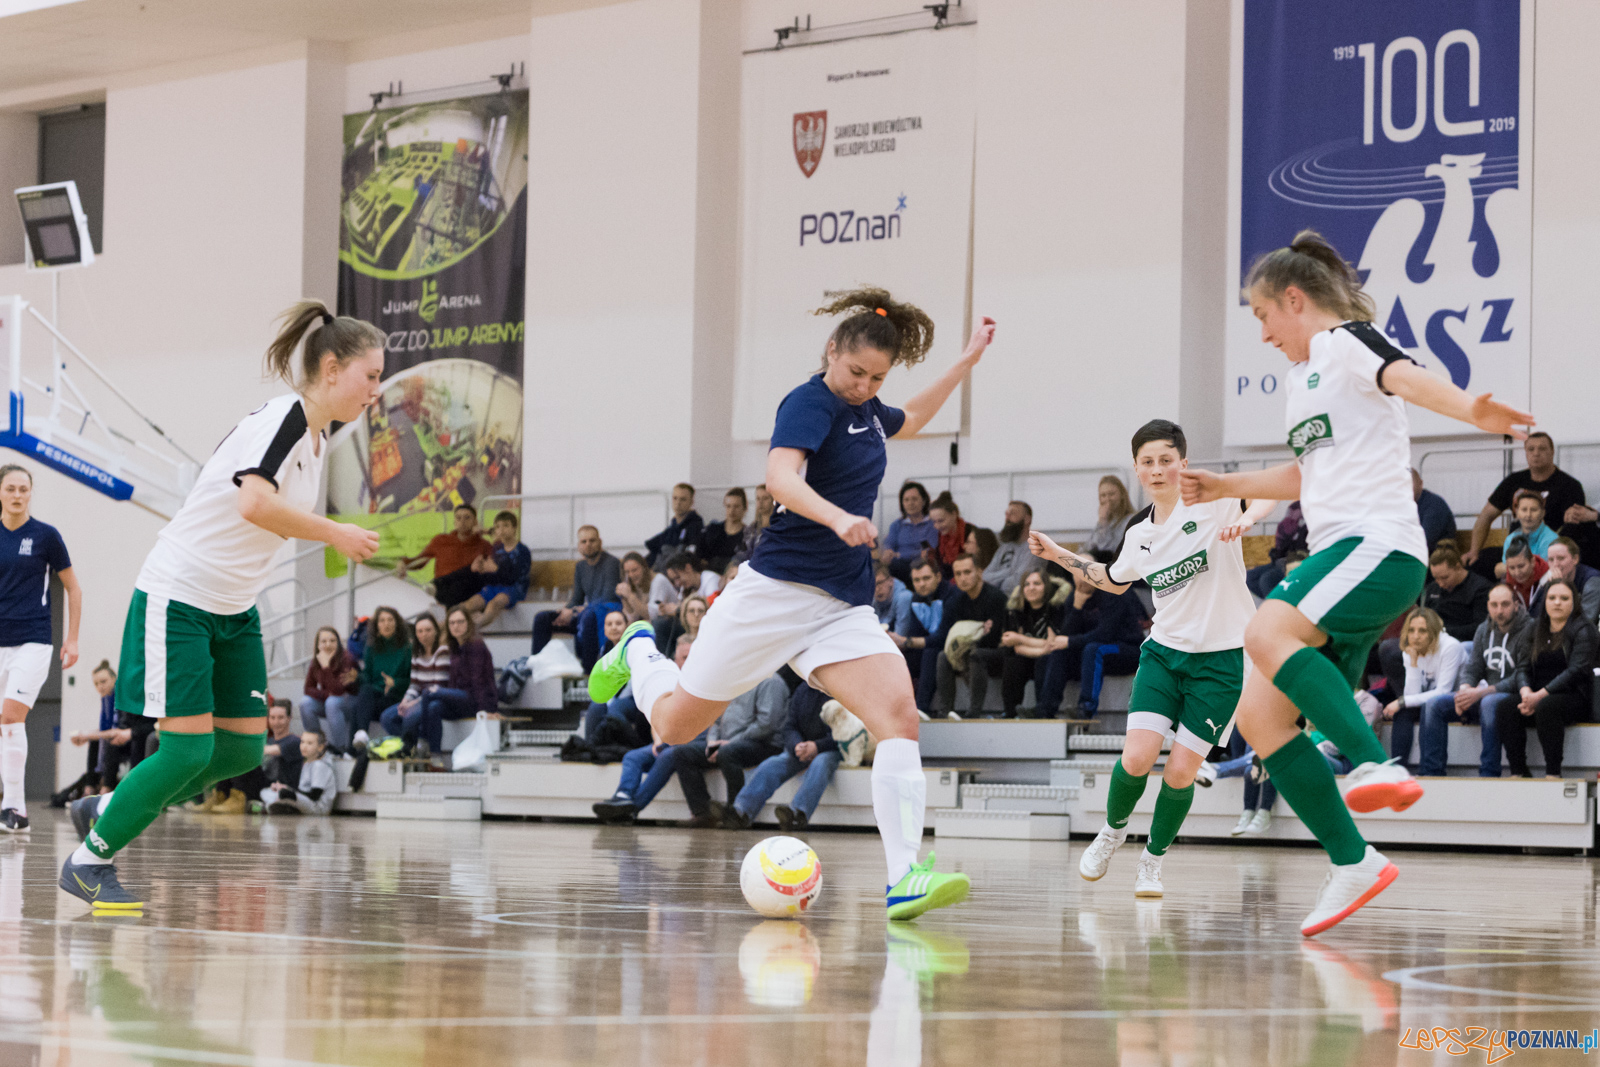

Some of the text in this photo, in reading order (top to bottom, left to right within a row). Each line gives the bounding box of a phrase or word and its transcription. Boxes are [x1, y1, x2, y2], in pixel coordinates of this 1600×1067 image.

[1333, 45, 1356, 61] 1919
[1489, 116, 1516, 133] 2019
[408, 329, 429, 351] DO
[429, 326, 469, 349] JUMP
[1152, 556, 1203, 587] REKORD
